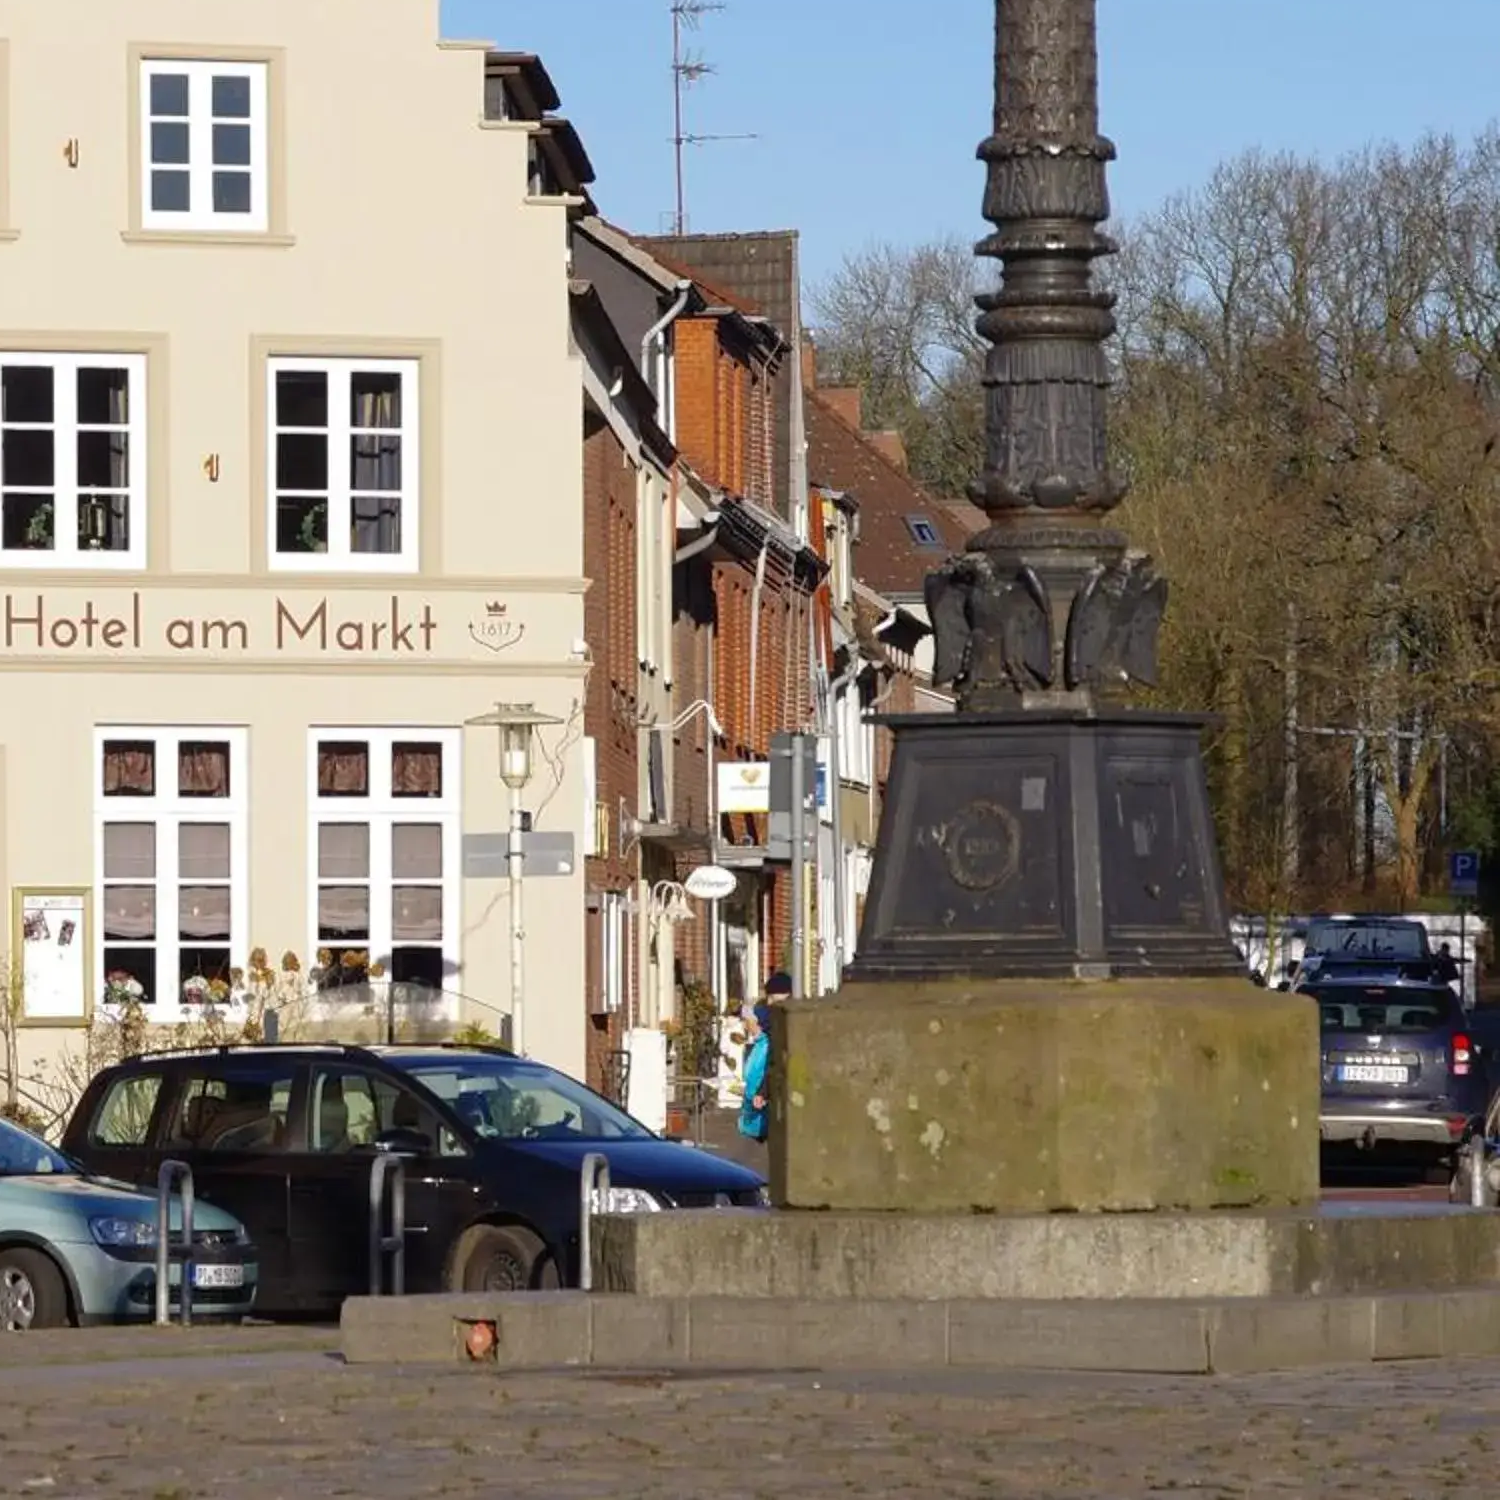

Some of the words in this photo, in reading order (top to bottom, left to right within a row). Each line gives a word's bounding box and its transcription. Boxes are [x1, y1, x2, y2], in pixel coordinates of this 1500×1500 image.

[5, 592, 140, 648] Hotel
[166, 620, 247, 649] am
[276, 596, 437, 651] Markt
[480, 621, 512, 637] 1617
[1456, 855, 1471, 877] P
